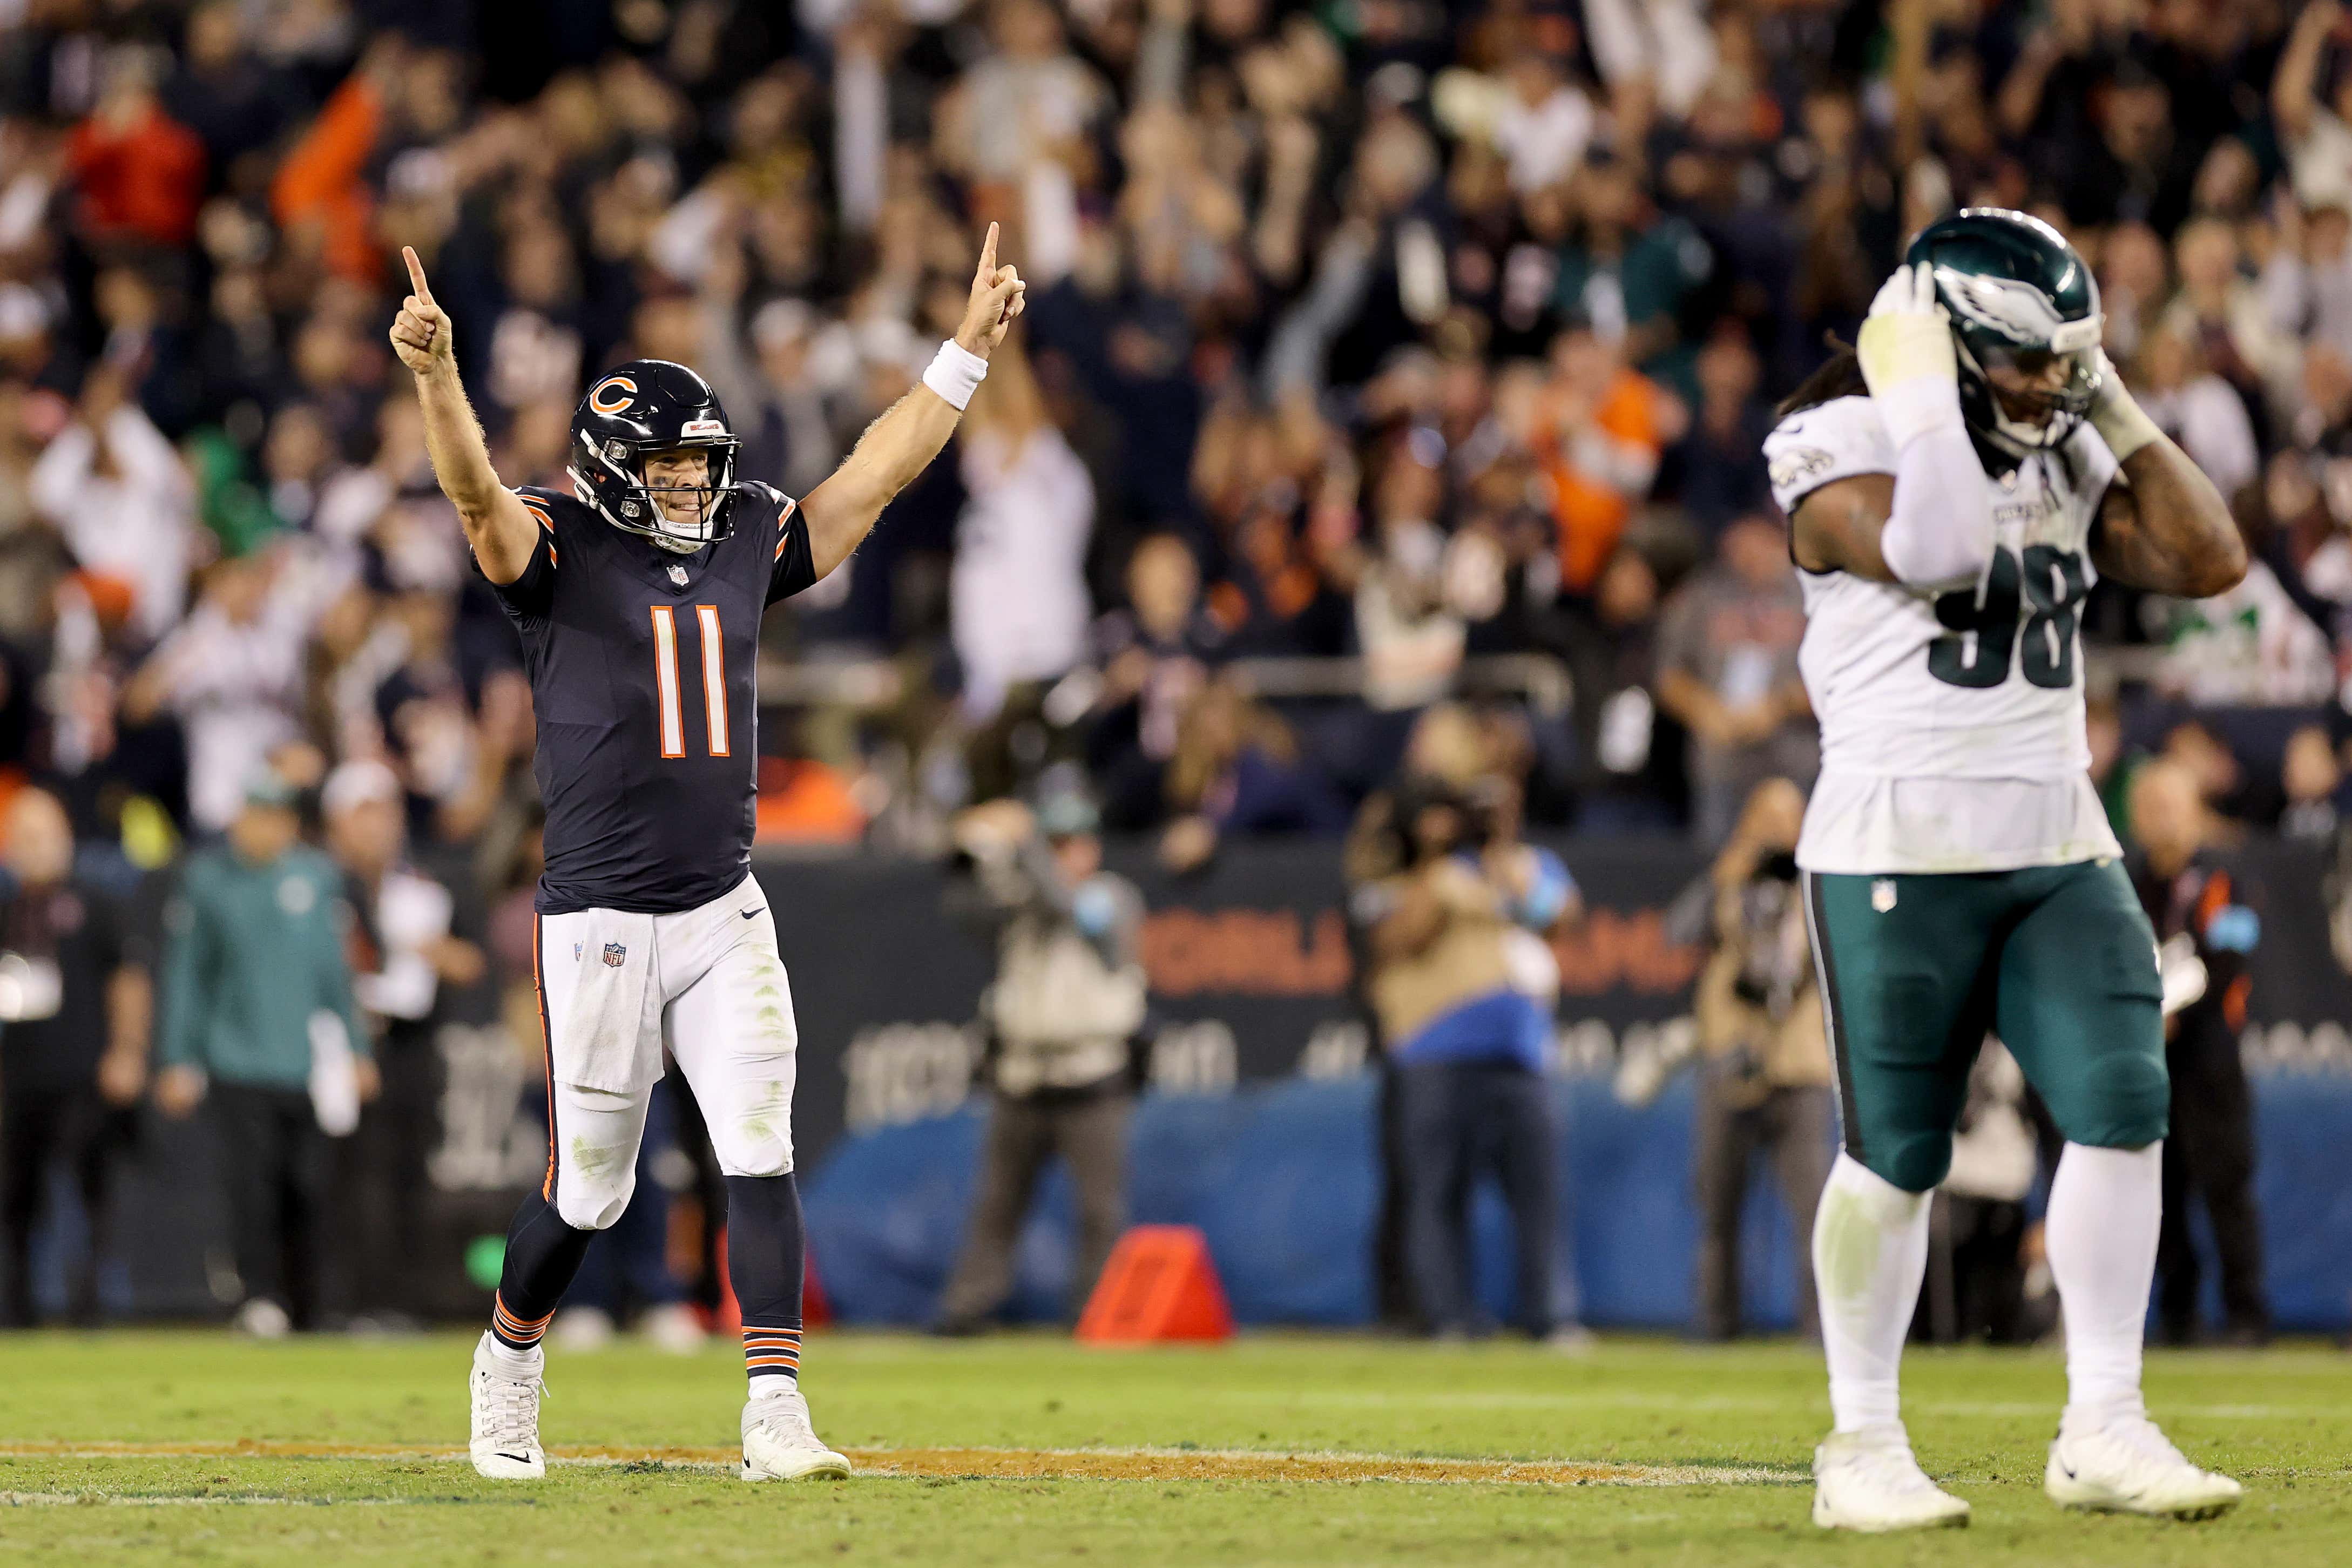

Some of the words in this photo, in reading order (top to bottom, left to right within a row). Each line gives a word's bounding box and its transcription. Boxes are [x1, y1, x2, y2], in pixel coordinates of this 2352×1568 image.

[590, 377, 638, 415] C
[1928, 544, 2087, 688] 98
[650, 605, 730, 759] 11
[605, 952, 622, 965] NFL
